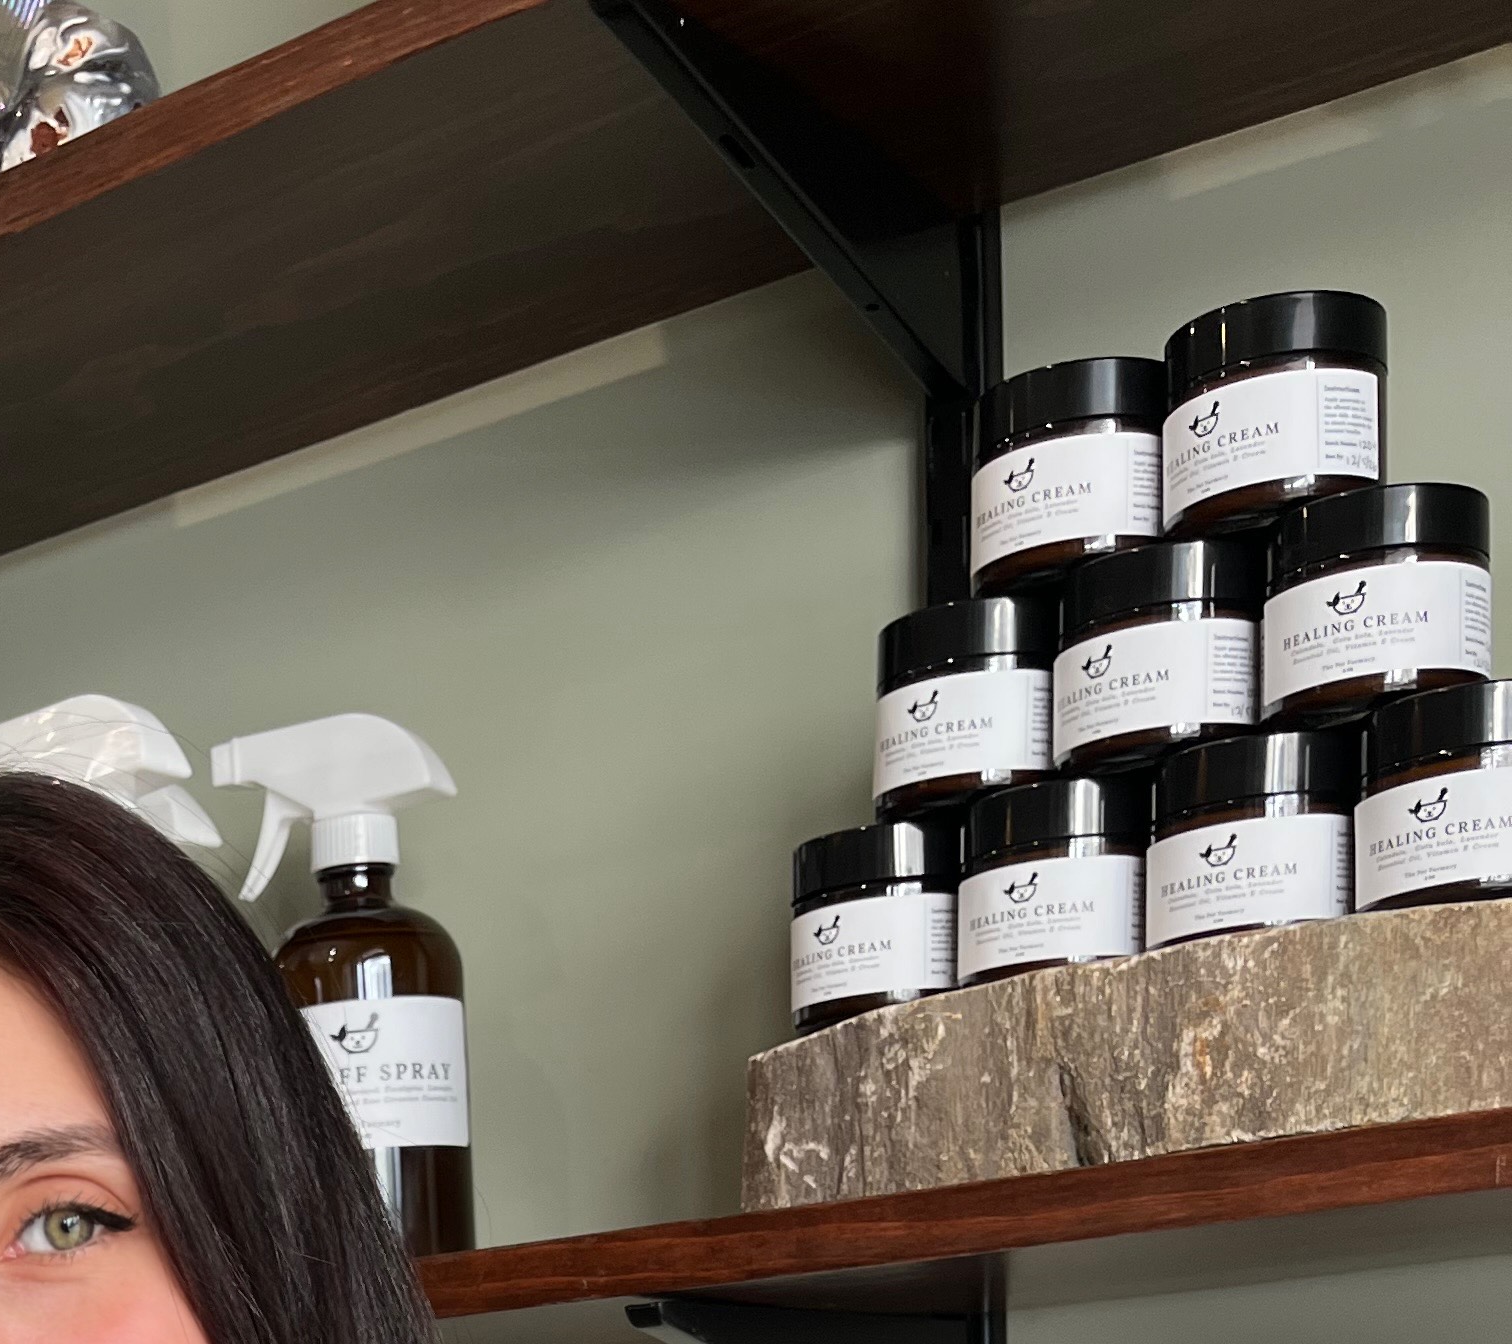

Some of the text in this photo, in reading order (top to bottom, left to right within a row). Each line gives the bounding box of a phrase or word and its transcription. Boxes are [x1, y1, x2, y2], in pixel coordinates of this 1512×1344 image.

[1217, 422, 1280, 448] CREAM
[1031, 481, 1093, 504] CREAM
[1283, 610, 1429, 651] HEALING CREAM
[1109, 668, 1171, 690] CREAM
[934, 716, 994, 735] CREAM
[1368, 815, 1512, 857] HEALING CREAM
[1161, 870, 1226, 898] HEALING
[1233, 862, 1298, 881] CREAM
[969, 907, 1028, 932] HEALING
[1034, 900, 1095, 918] CREAM
[837, 939, 893, 957] CREAM
[379, 1062, 452, 1081] SPRAY
